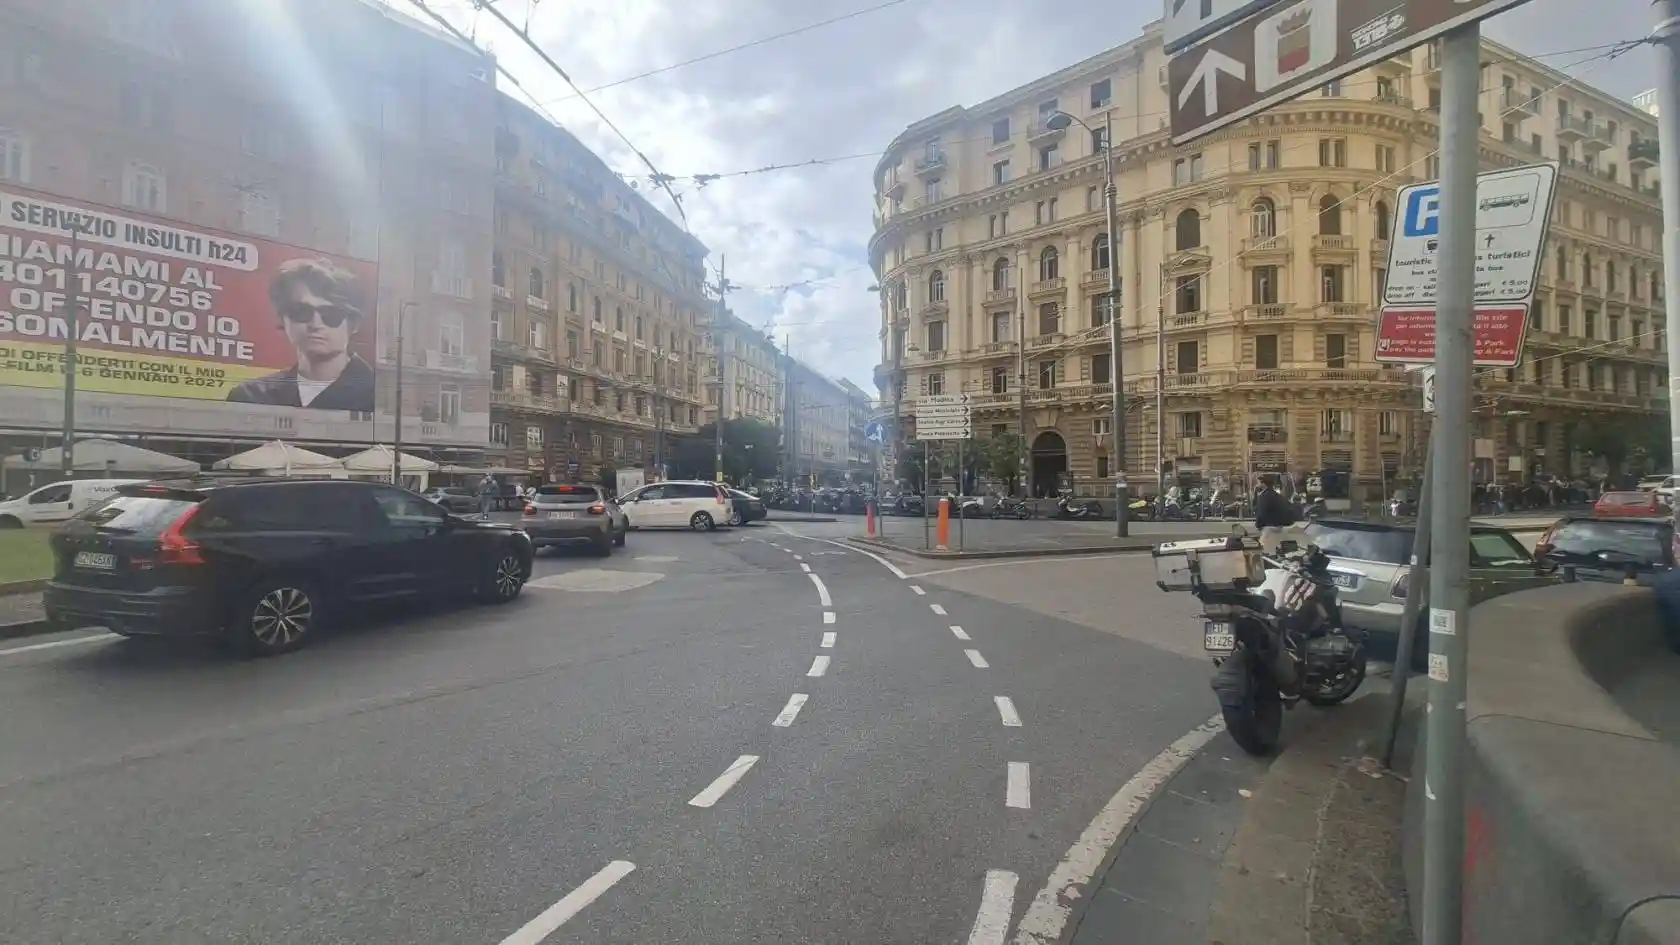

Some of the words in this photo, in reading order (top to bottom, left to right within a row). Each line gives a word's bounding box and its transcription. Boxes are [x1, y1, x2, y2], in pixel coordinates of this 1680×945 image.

[125, 223, 201, 256] INSULTI
[208, 240, 247, 266] h24
[180, 266, 223, 292] AL
[207, 314, 240, 337] IO
[22, 350, 137, 370] OFFENDERTI
[139, 361, 174, 374] CON
[82, 366, 93, 377] 6
[100, 367, 181, 384] GENNAIO
[184, 376, 226, 389] 2027
